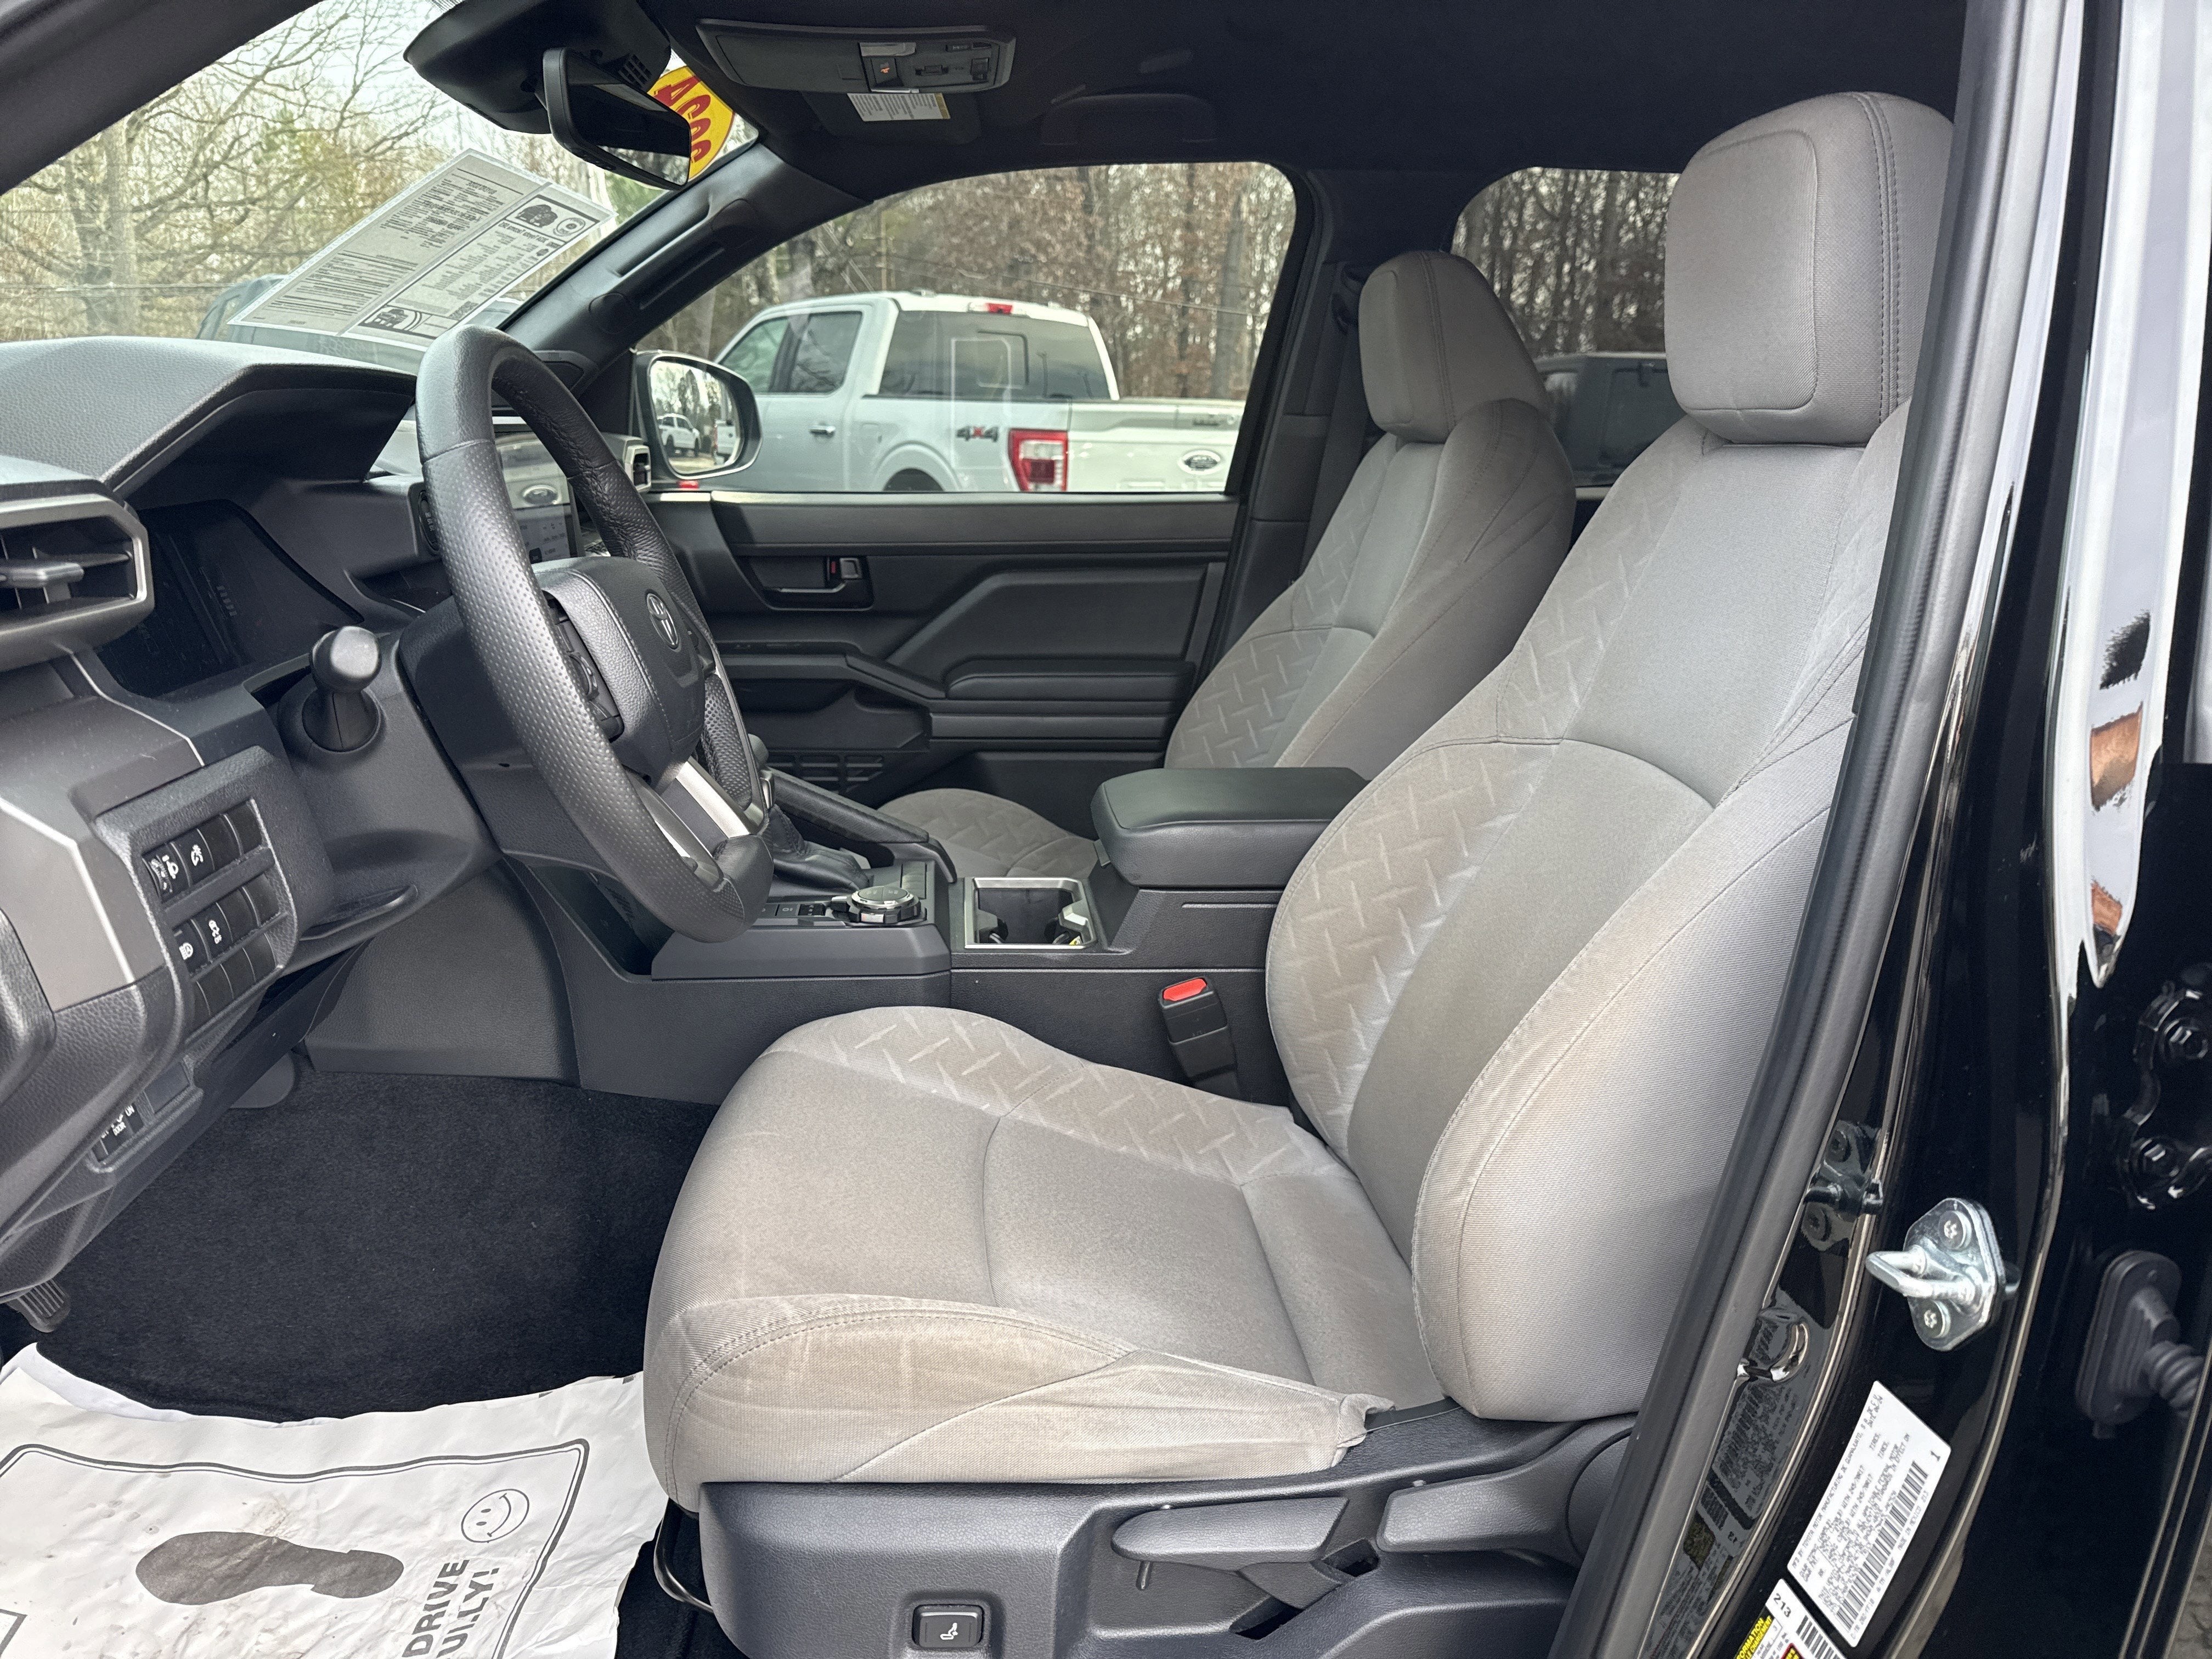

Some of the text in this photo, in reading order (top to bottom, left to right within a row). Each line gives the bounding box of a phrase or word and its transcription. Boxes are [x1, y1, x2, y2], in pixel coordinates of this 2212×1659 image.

[1802, 1528, 1814, 1549] TOYOTA
[1812, 1511, 1822, 1530] MOTOR
[1821, 1471, 1843, 1514] MANUFACTURING
[402, 1560, 470, 1656] DRIVE
[1773, 1593, 1791, 1618] 213
